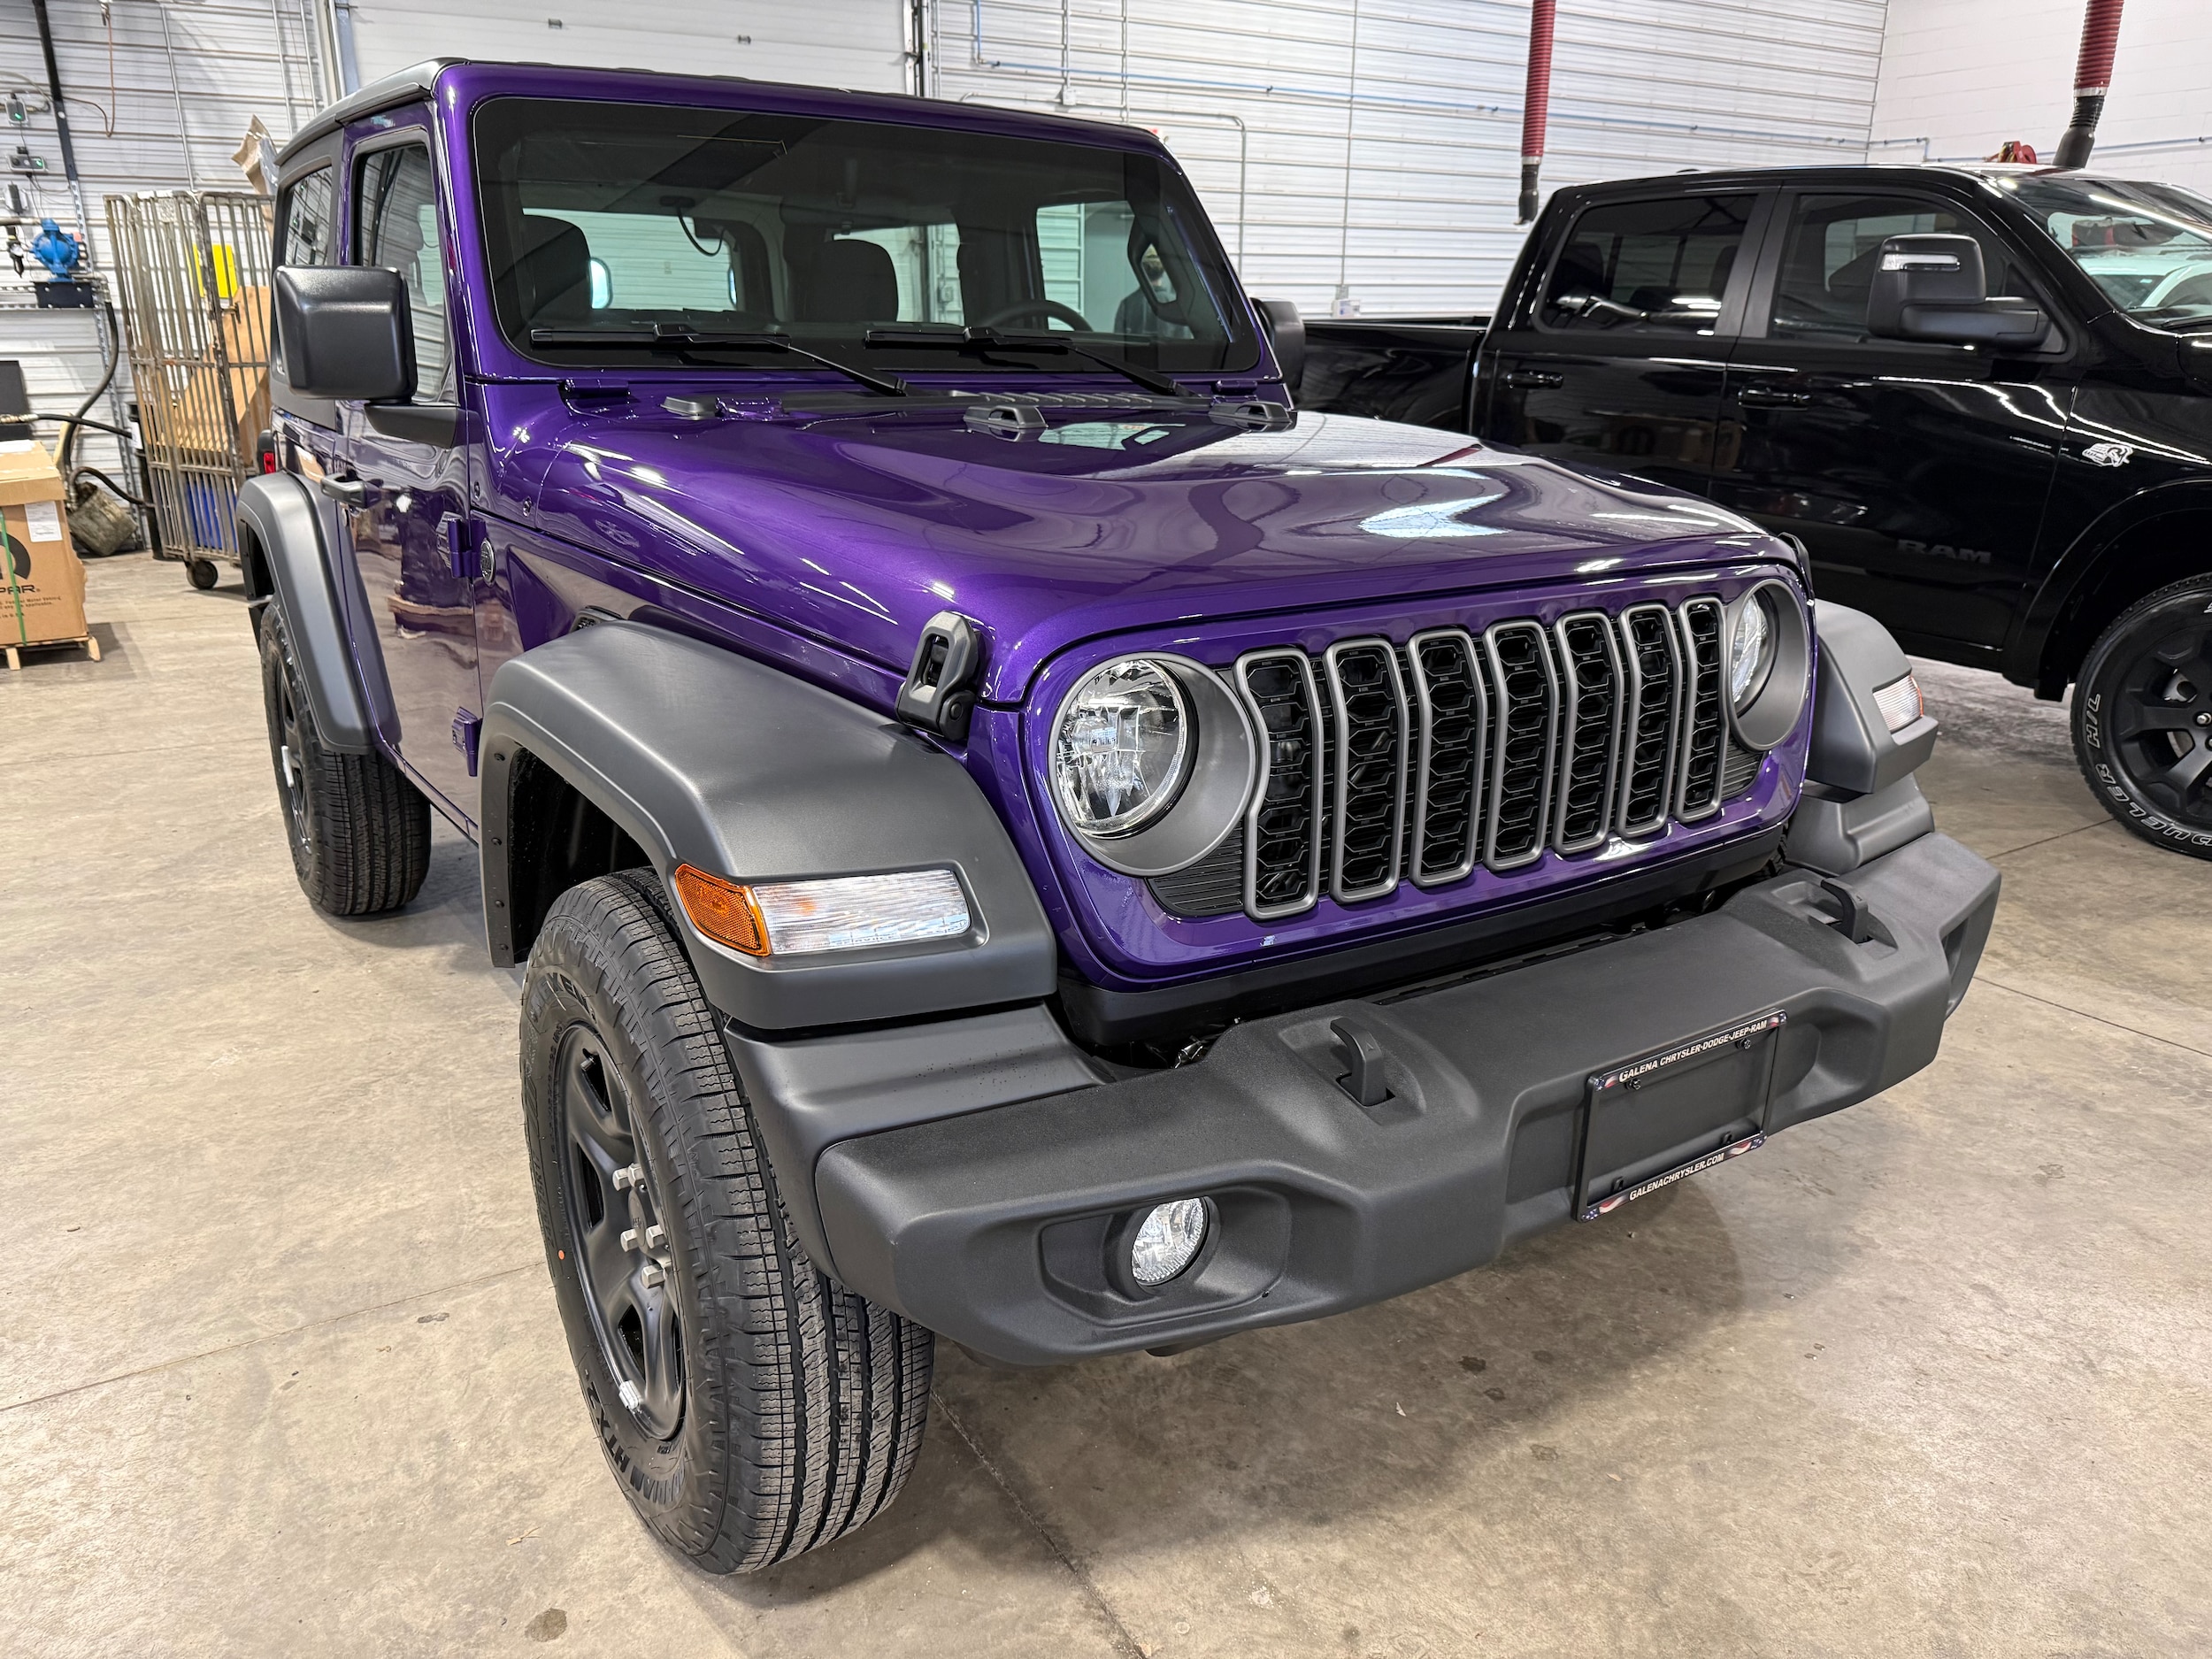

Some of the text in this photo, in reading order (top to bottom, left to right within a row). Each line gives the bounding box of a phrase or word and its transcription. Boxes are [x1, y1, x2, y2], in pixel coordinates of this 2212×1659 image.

[1897, 538, 1992, 565] RAM
[2085, 693, 2101, 749] H/L
[2095, 763, 2212, 847] DUELER
[1618, 1060, 1658, 1083] GALENA
[1629, 1153, 1724, 1202] GALENACHRYSLER.COM
[596, 1407, 630, 1473] HTX
